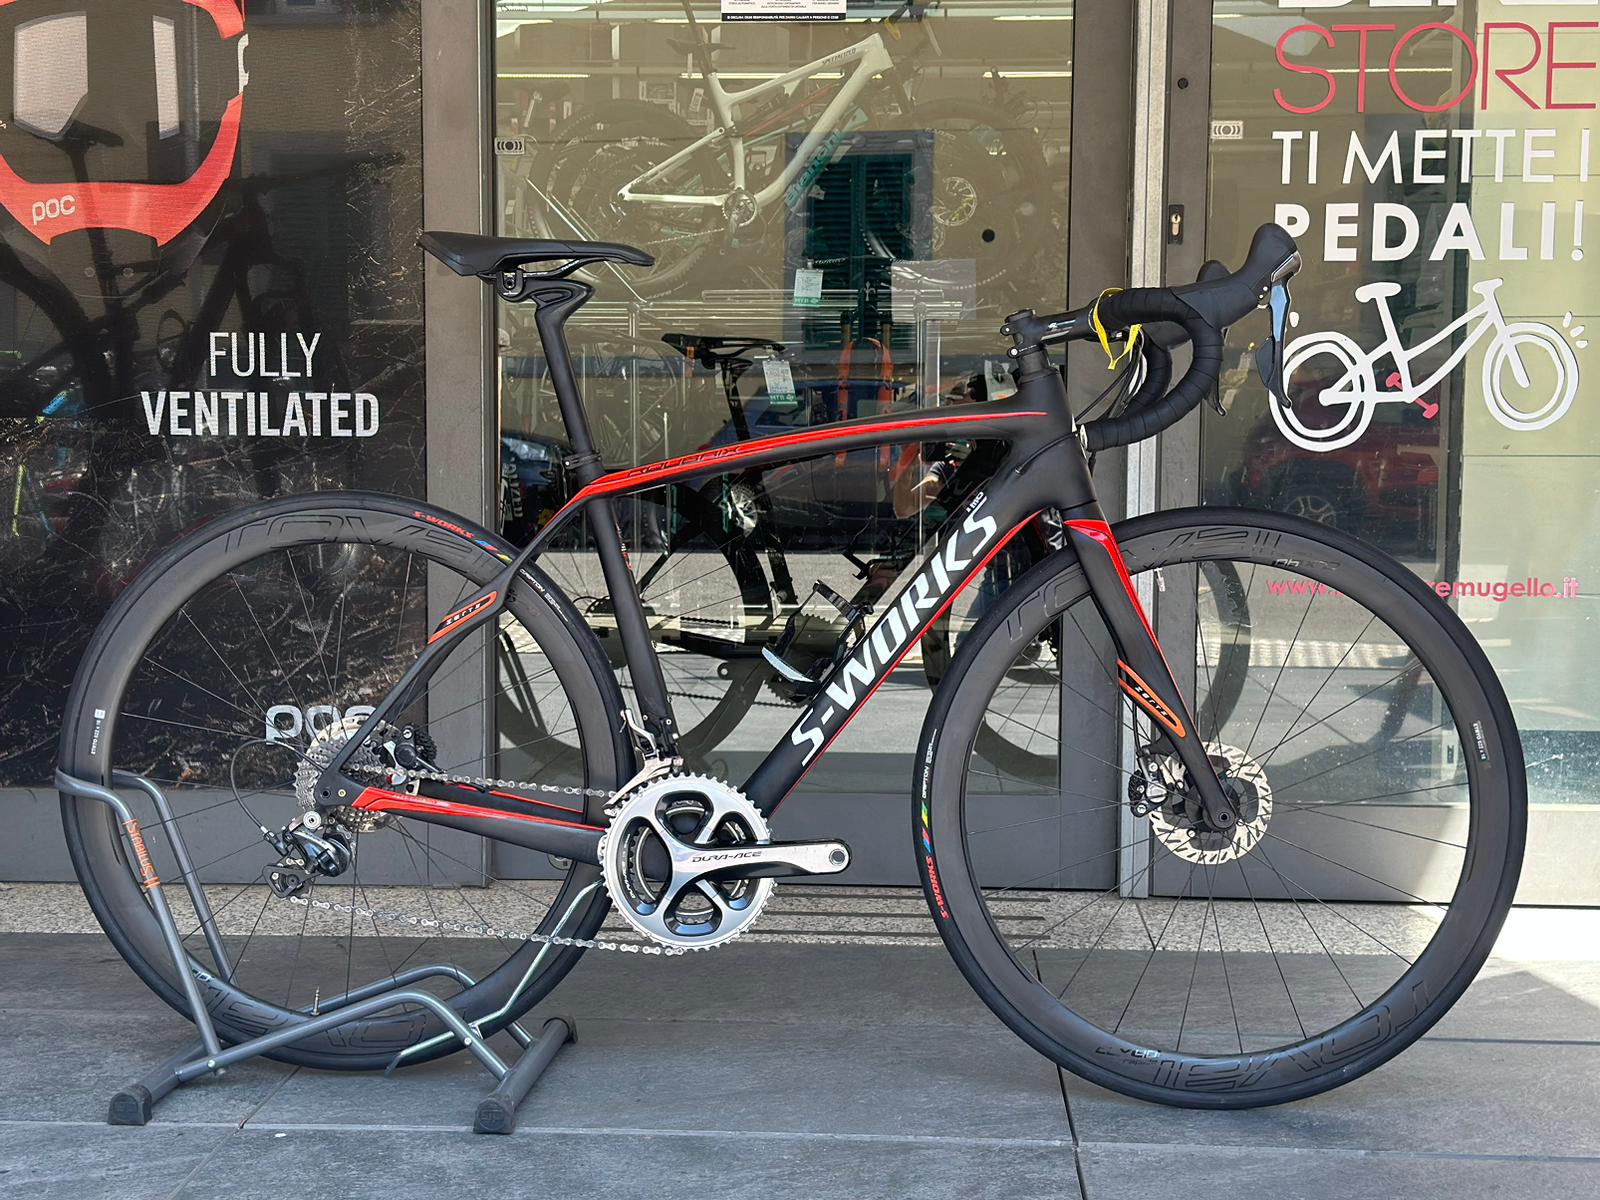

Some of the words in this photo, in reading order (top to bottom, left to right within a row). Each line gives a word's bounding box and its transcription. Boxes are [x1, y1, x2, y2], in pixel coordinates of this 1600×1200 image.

[1273, 22, 1599, 114] STORE
[1272, 130, 1319, 184] TI
[1343, 128, 1556, 184] METTE
[1580, 128, 1590, 183] I
[1274, 200, 1585, 262] PEDALI!
[210, 332, 321, 378] FULLY
[141, 391, 380, 437] VENTILATED
[412, 510, 475, 540] S-WORKS
[791, 496, 997, 767] S-WORKS
[692, 851, 762, 863] DURA-ACE
[926, 856, 949, 920] S-WORKS
